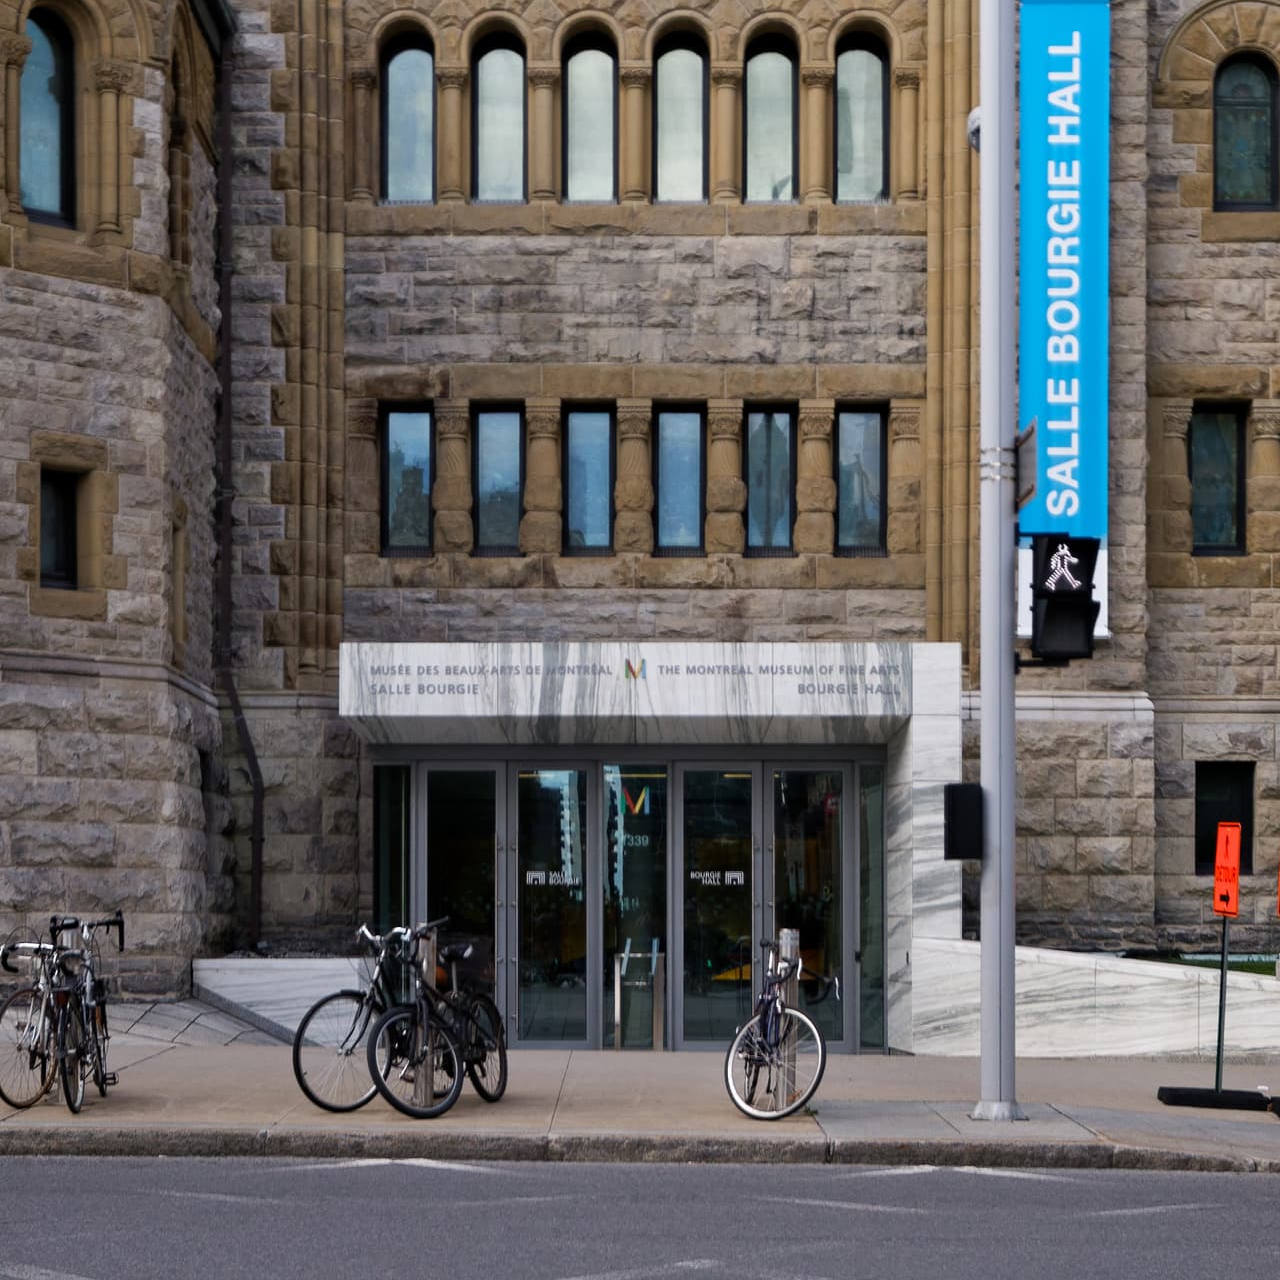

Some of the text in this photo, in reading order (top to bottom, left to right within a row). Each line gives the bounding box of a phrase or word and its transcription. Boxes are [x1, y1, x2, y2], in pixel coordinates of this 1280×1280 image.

[1046, 30, 1081, 517] SALLE BOURGIE HALL
[370, 663, 613, 676] MUSÉE DES BEAUX-ARTS DE MONTRÉAL
[658, 665, 900, 676] THE MONTREAL MUSEUM OF FINE ARTS
[370, 684, 480, 695] SALLE BOURGIE
[797, 684, 901, 695] BOURGIE HALL
[690, 870, 721, 878] BOURGIE
[702, 877, 721, 885] HALL
